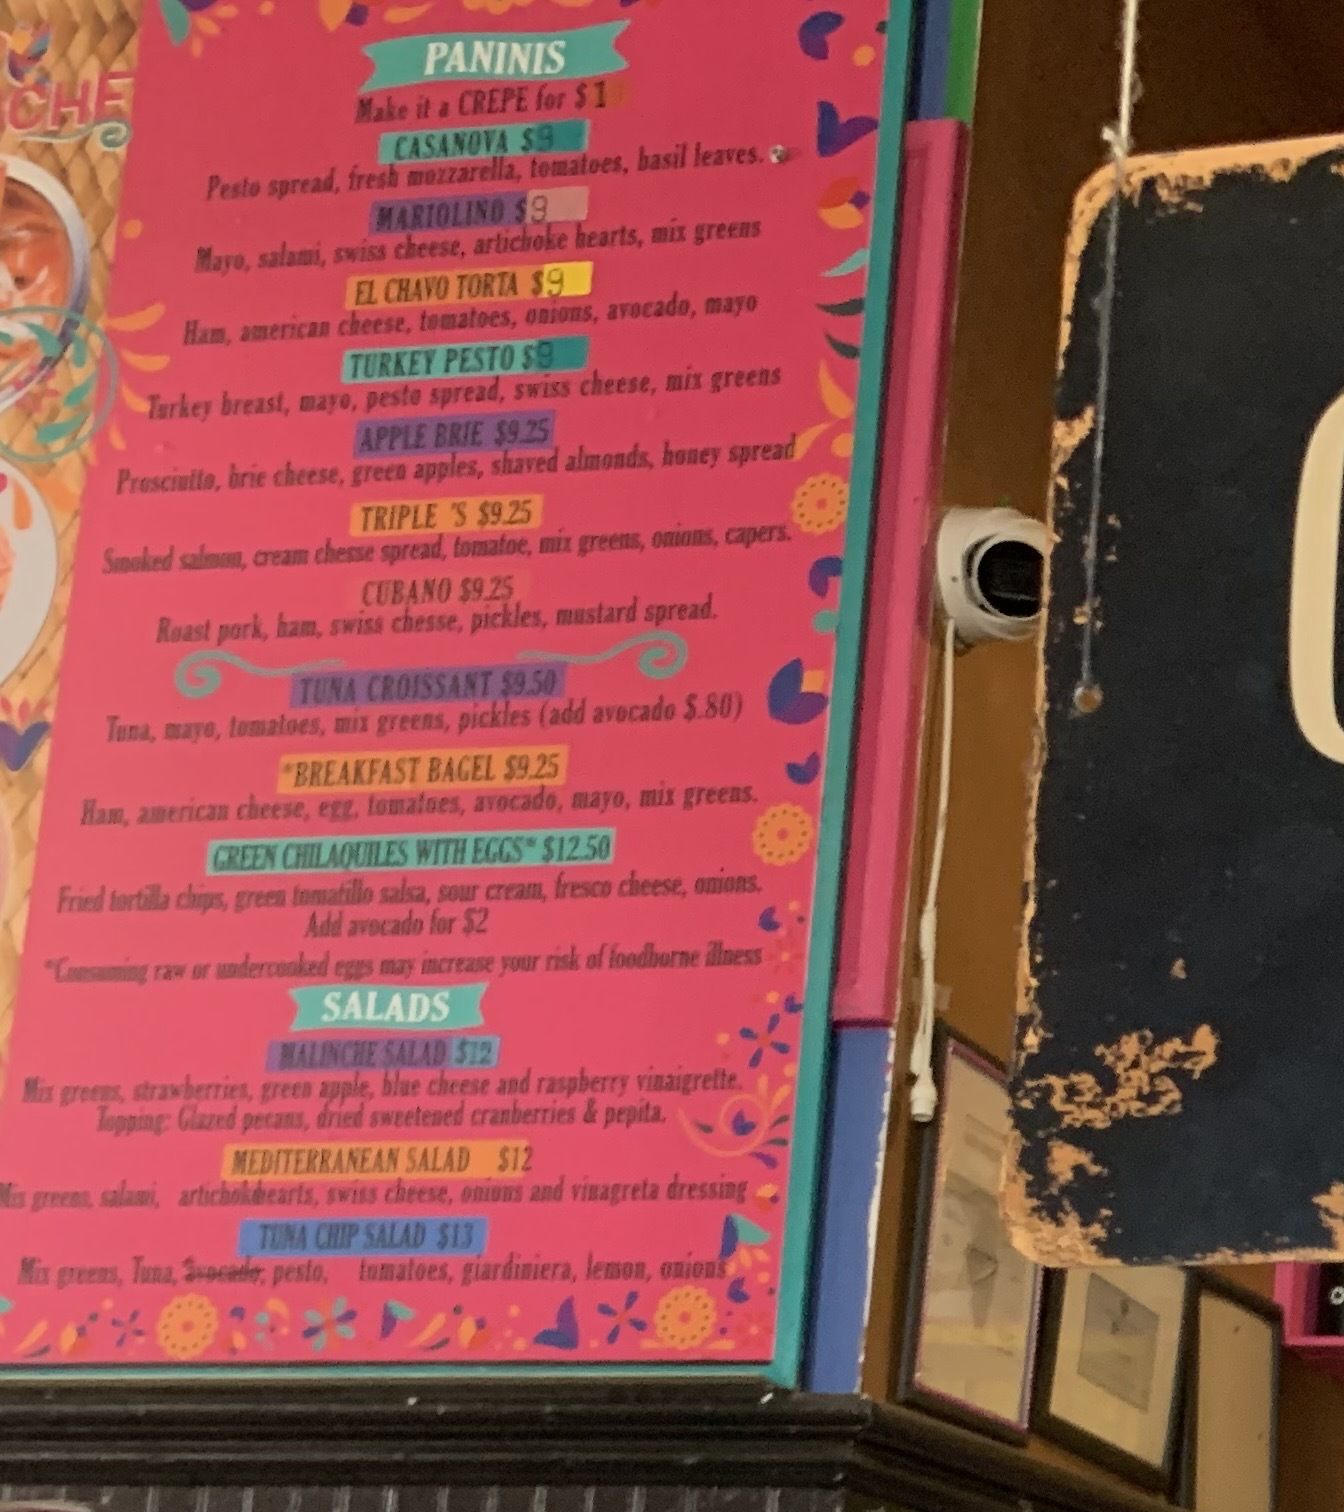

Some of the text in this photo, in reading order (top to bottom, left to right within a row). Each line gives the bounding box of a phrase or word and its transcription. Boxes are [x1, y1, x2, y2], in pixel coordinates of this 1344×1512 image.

[423, 40, 567, 75] PANINIS
[0, 72, 134, 131] CHE
[356, 93, 408, 124] Make
[416, 92, 431, 120] it
[438, 99, 450, 119] a
[457, 86, 529, 117] CREPE
[535, 84, 566, 113] for
[393, 127, 553, 161] CASANOVA $9
[206, 143, 763, 201] Pesto spread, fresh mozzarella, tomatoes, basil leaves.
[376, 199, 548, 231] MARIOLINO $9
[196, 247, 252, 276] Mayo,
[333, 237, 387, 264] swiss
[393, 233, 467, 261] cheese,
[473, 225, 568, 256] artichoke
[575, 223, 645, 249] hearts,
[650, 218, 687, 244] mix
[694, 221, 761, 247] greens
[355, 270, 564, 306] EL CHAVO TORTA $9
[184, 291, 757, 347] Ham, american cheese, tomatoes, onions, avocado, mayo
[352, 344, 554, 379] TURKEY PESTO $9
[149, 366, 780, 422] Turkey breast, mayo, pesto spread, swiss cheese, mix greens
[360, 419, 549, 452] APPLE BRIE $9.25
[116, 433, 795, 495] Prosciutto, brie cheese, green apples, shaved almonds, honey spread
[362, 503, 437, 532] TRIPLE
[477, 499, 532, 526] $9.25
[360, 574, 514, 608] CUBANO $9.25
[156, 617, 211, 643] Roast
[330, 609, 384, 636] swiss
[471, 602, 549, 635] pickles,
[555, 597, 639, 626] mustard
[644, 594, 718, 628] spread.
[301, 668, 556, 705] TUNA CROISSANT $9.50
[108, 696, 676, 744] Tuna, mayo, tomatoes, mix greens, pickles (add avocado
[427, 755, 497, 783] BAGEL
[503, 753, 558, 780] $9.25
[367, 791, 466, 817] tomatoes,
[474, 783, 564, 813] avocado,
[571, 789, 631, 814] mayo,
[639, 780, 676, 807] mix
[683, 785, 758, 811] greens.
[212, 845, 276, 873] GREEN
[280, 841, 409, 872] CHILAQUILES
[416, 839, 466, 867] WITH
[541, 835, 611, 863] $12.50
[617, 870, 689, 899] cheese,
[305, 908, 488, 938] Add avocado for $2
[321, 991, 450, 1023] SALADS
[536, 1067, 628, 1099] raspberry
[470, 1099, 576, 1126] cranberries
[232, 1146, 533, 1175] MEDITERRANEAN SALAD $12
[260, 1222, 473, 1250] TUNA CHIP SALAD $13
